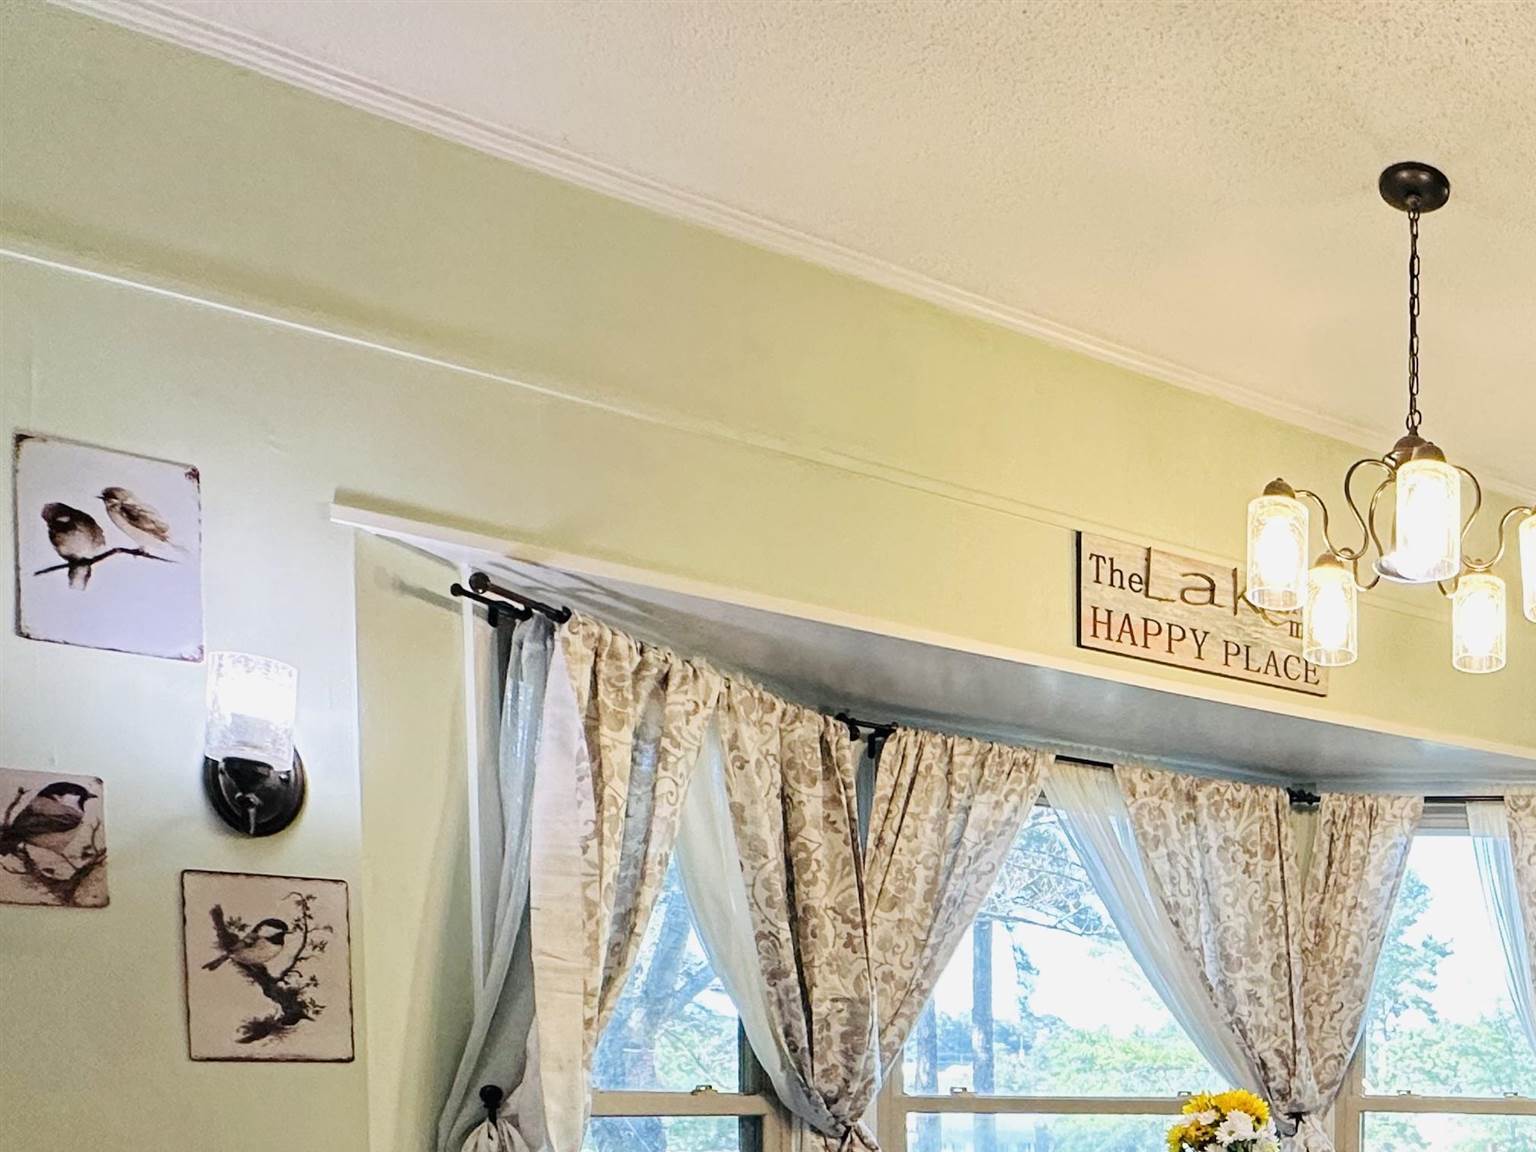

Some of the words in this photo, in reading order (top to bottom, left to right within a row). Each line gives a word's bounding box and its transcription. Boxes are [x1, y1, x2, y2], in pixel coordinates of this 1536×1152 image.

[1089, 553, 1143, 593] The
[1090, 605, 1210, 660] HAPPY
[1223, 639, 1320, 685] PLACE
